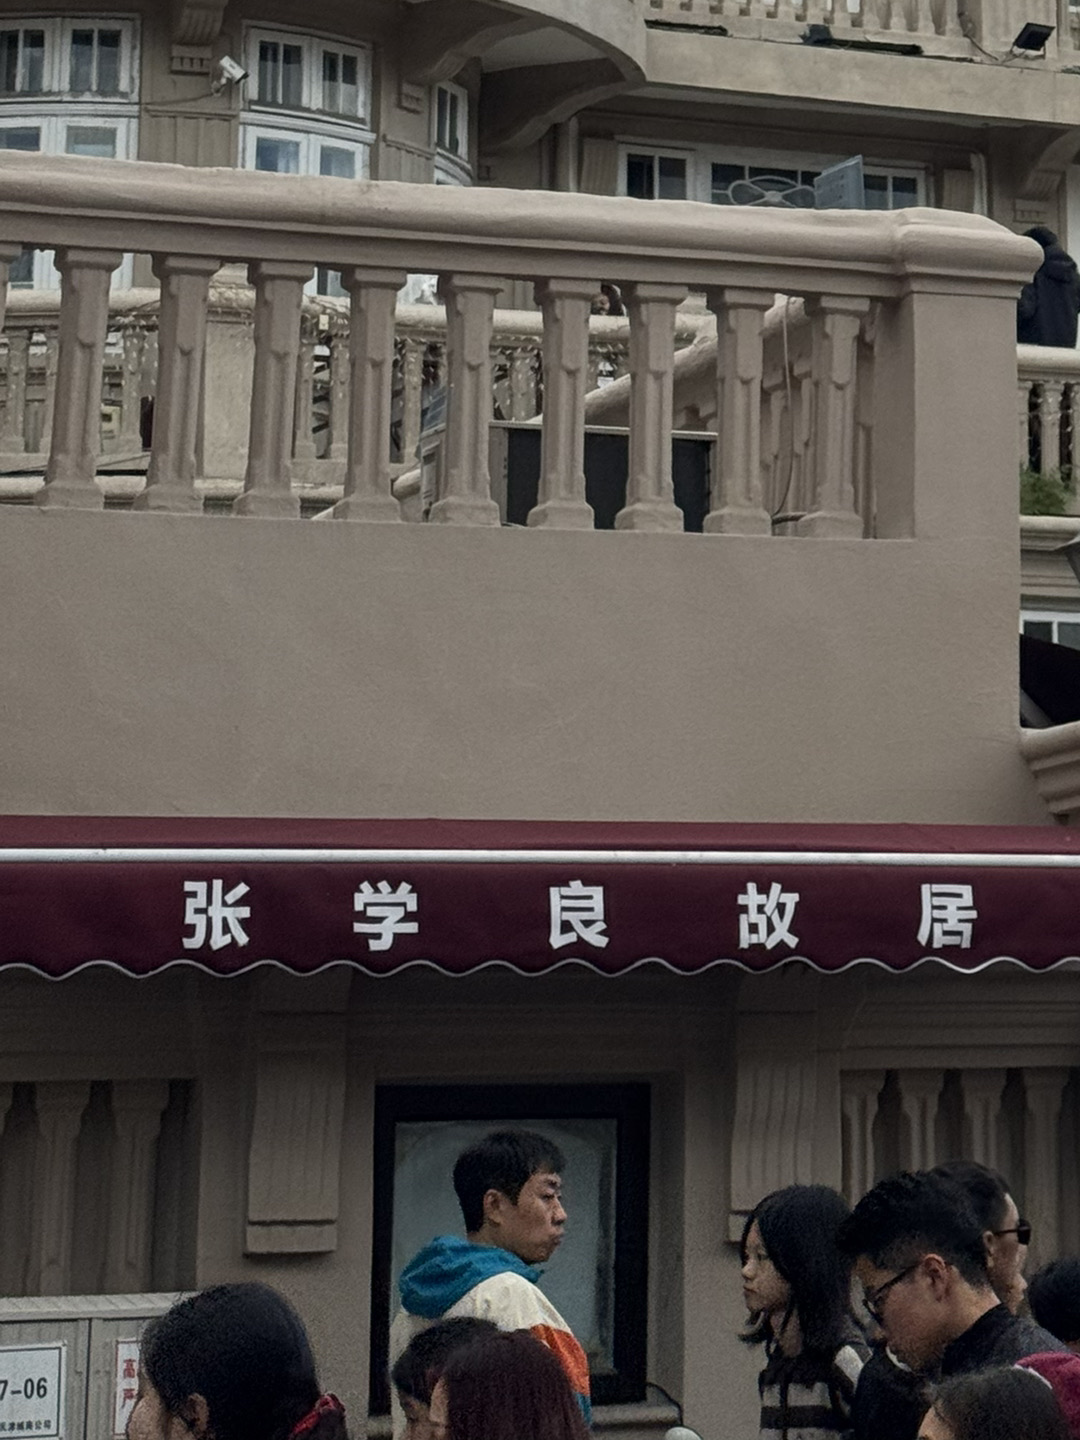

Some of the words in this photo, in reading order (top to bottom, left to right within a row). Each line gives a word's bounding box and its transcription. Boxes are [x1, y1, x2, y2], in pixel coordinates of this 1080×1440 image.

[182, 879, 979, 952] 张学良故居
